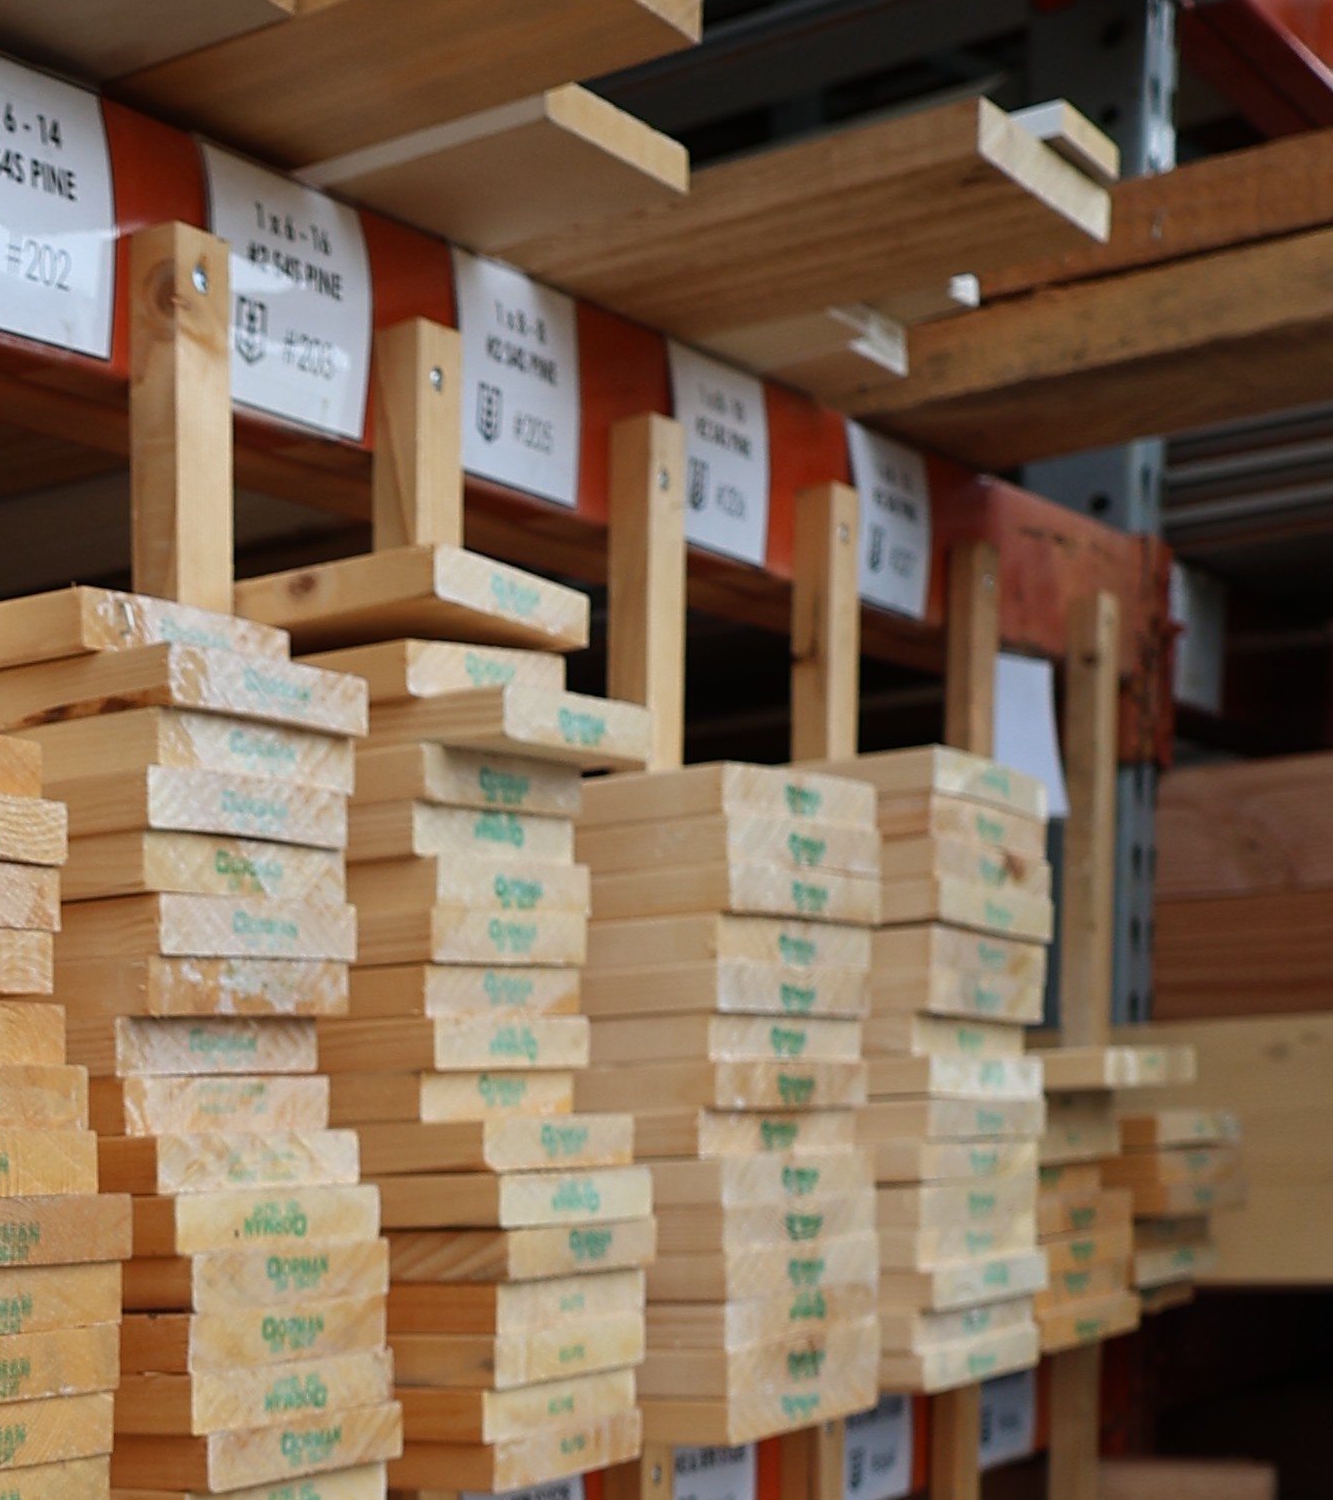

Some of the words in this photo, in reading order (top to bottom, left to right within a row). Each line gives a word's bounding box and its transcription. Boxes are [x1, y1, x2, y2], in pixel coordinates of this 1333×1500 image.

[4, 102, 17, 133] 6
[36, 113, 63, 149] 14
[31, 158, 78, 202] PINE
[6, 231, 72, 291] #202
[305, 262, 343, 302] PINE
